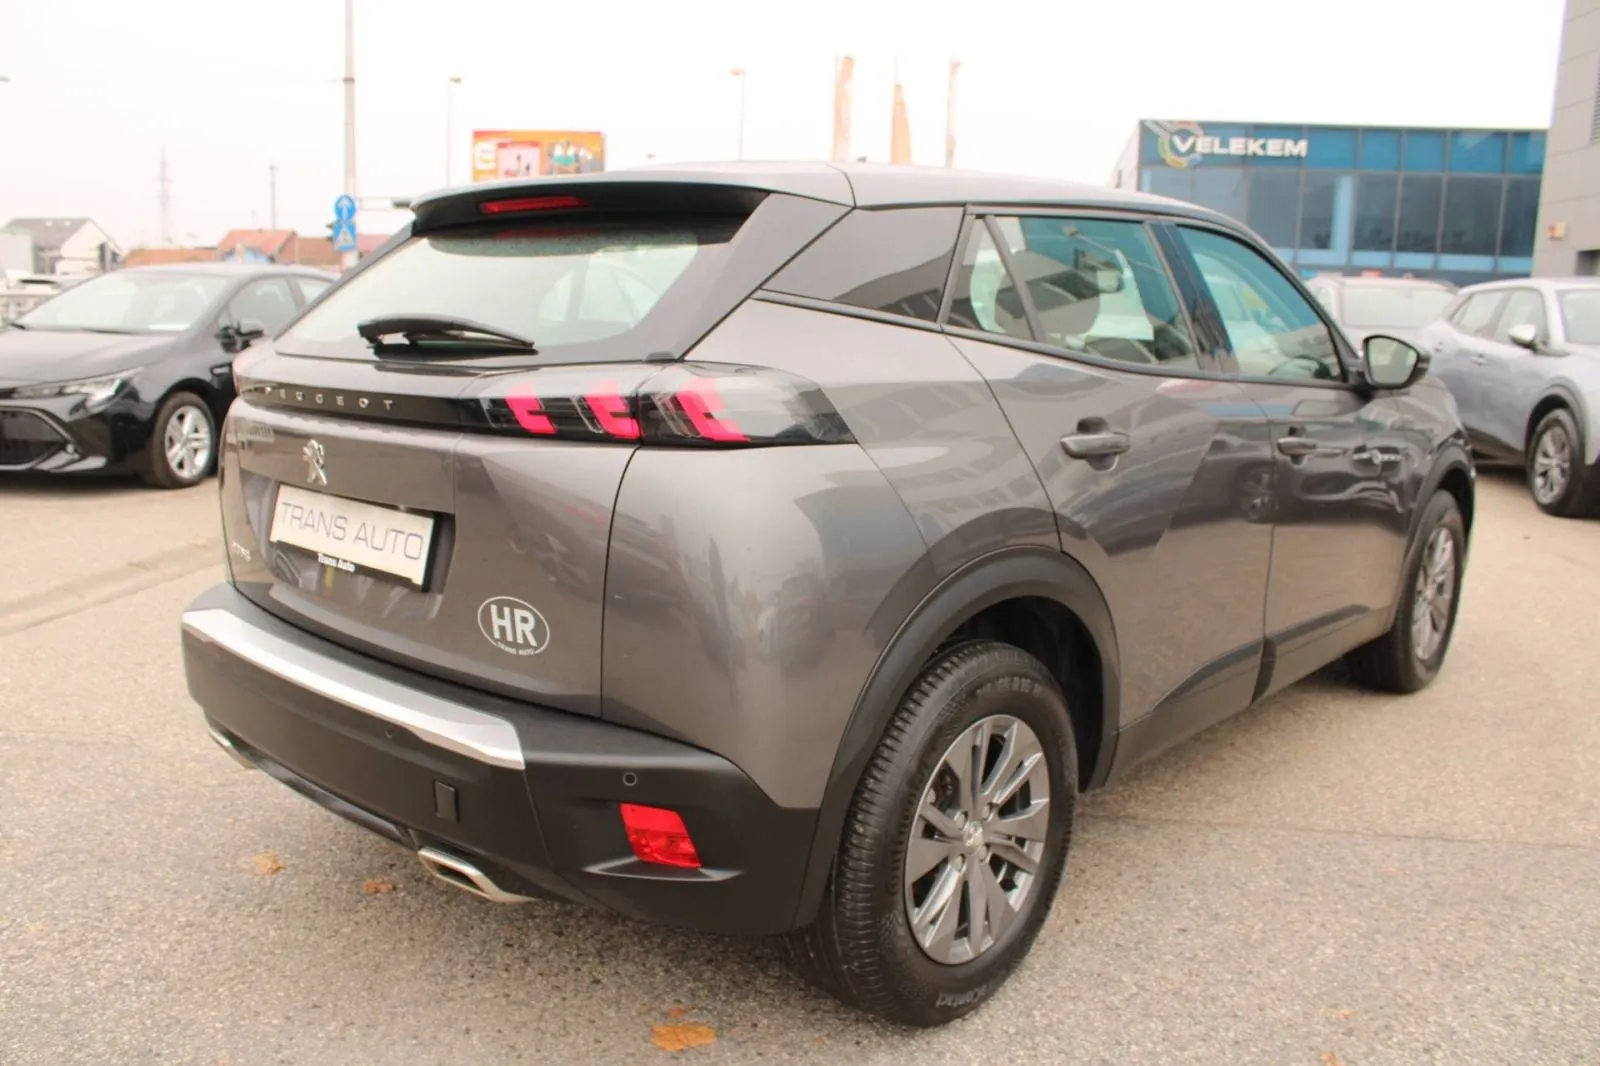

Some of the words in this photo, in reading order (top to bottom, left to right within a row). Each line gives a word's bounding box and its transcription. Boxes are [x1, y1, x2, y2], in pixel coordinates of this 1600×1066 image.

[1172, 135, 1308, 158] VELEKEM
[281, 502, 348, 541] TRANS
[353, 522, 424, 561] AUTO
[490, 604, 538, 647] HR
